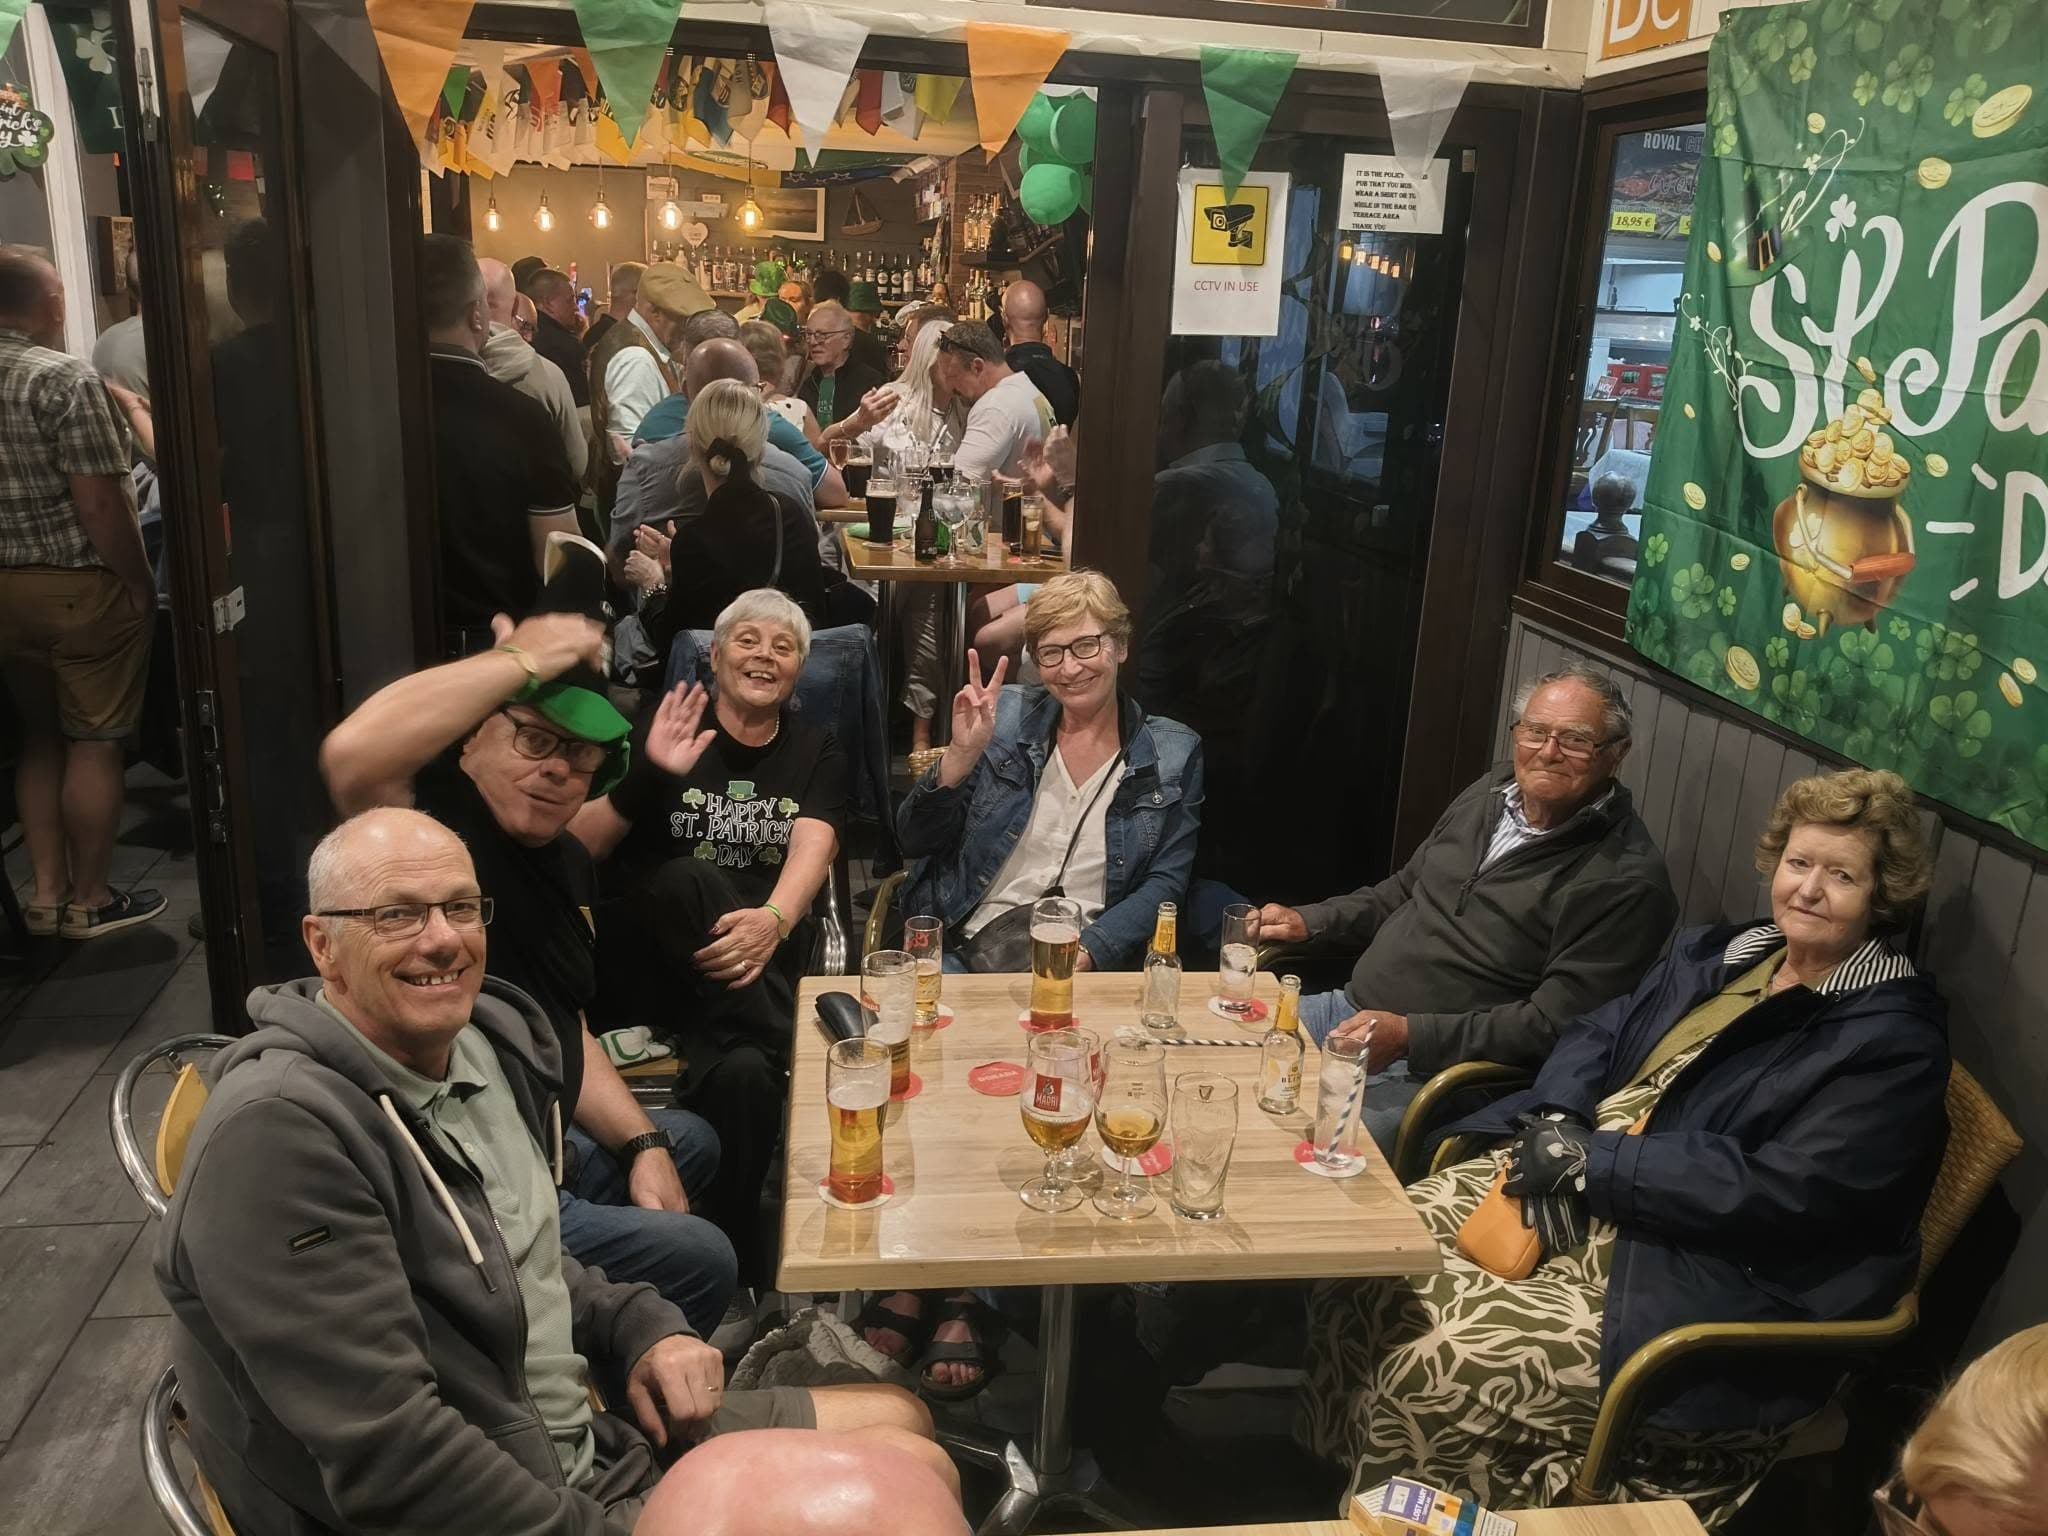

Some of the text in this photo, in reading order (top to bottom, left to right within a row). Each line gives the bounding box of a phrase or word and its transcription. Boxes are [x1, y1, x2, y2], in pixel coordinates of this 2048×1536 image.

[1643, 132, 1682, 152] ROYAL
[1353, 201, 1373, 209] WHILE
[1353, 211, 1400, 220] TERRACE AREA
[1615, 216, 1653, 228] 18,95 €
[1352, 222, 1386, 231] THANK YOU
[1193, 280, 1259, 292] CCTV IN USE
[705, 792, 778, 825] HAPPY
[670, 811, 703, 838] ST.
[717, 844, 763, 868] DAY
[1416, 1487, 1428, 1505] MARY
[1411, 1503, 1423, 1521] LOST
